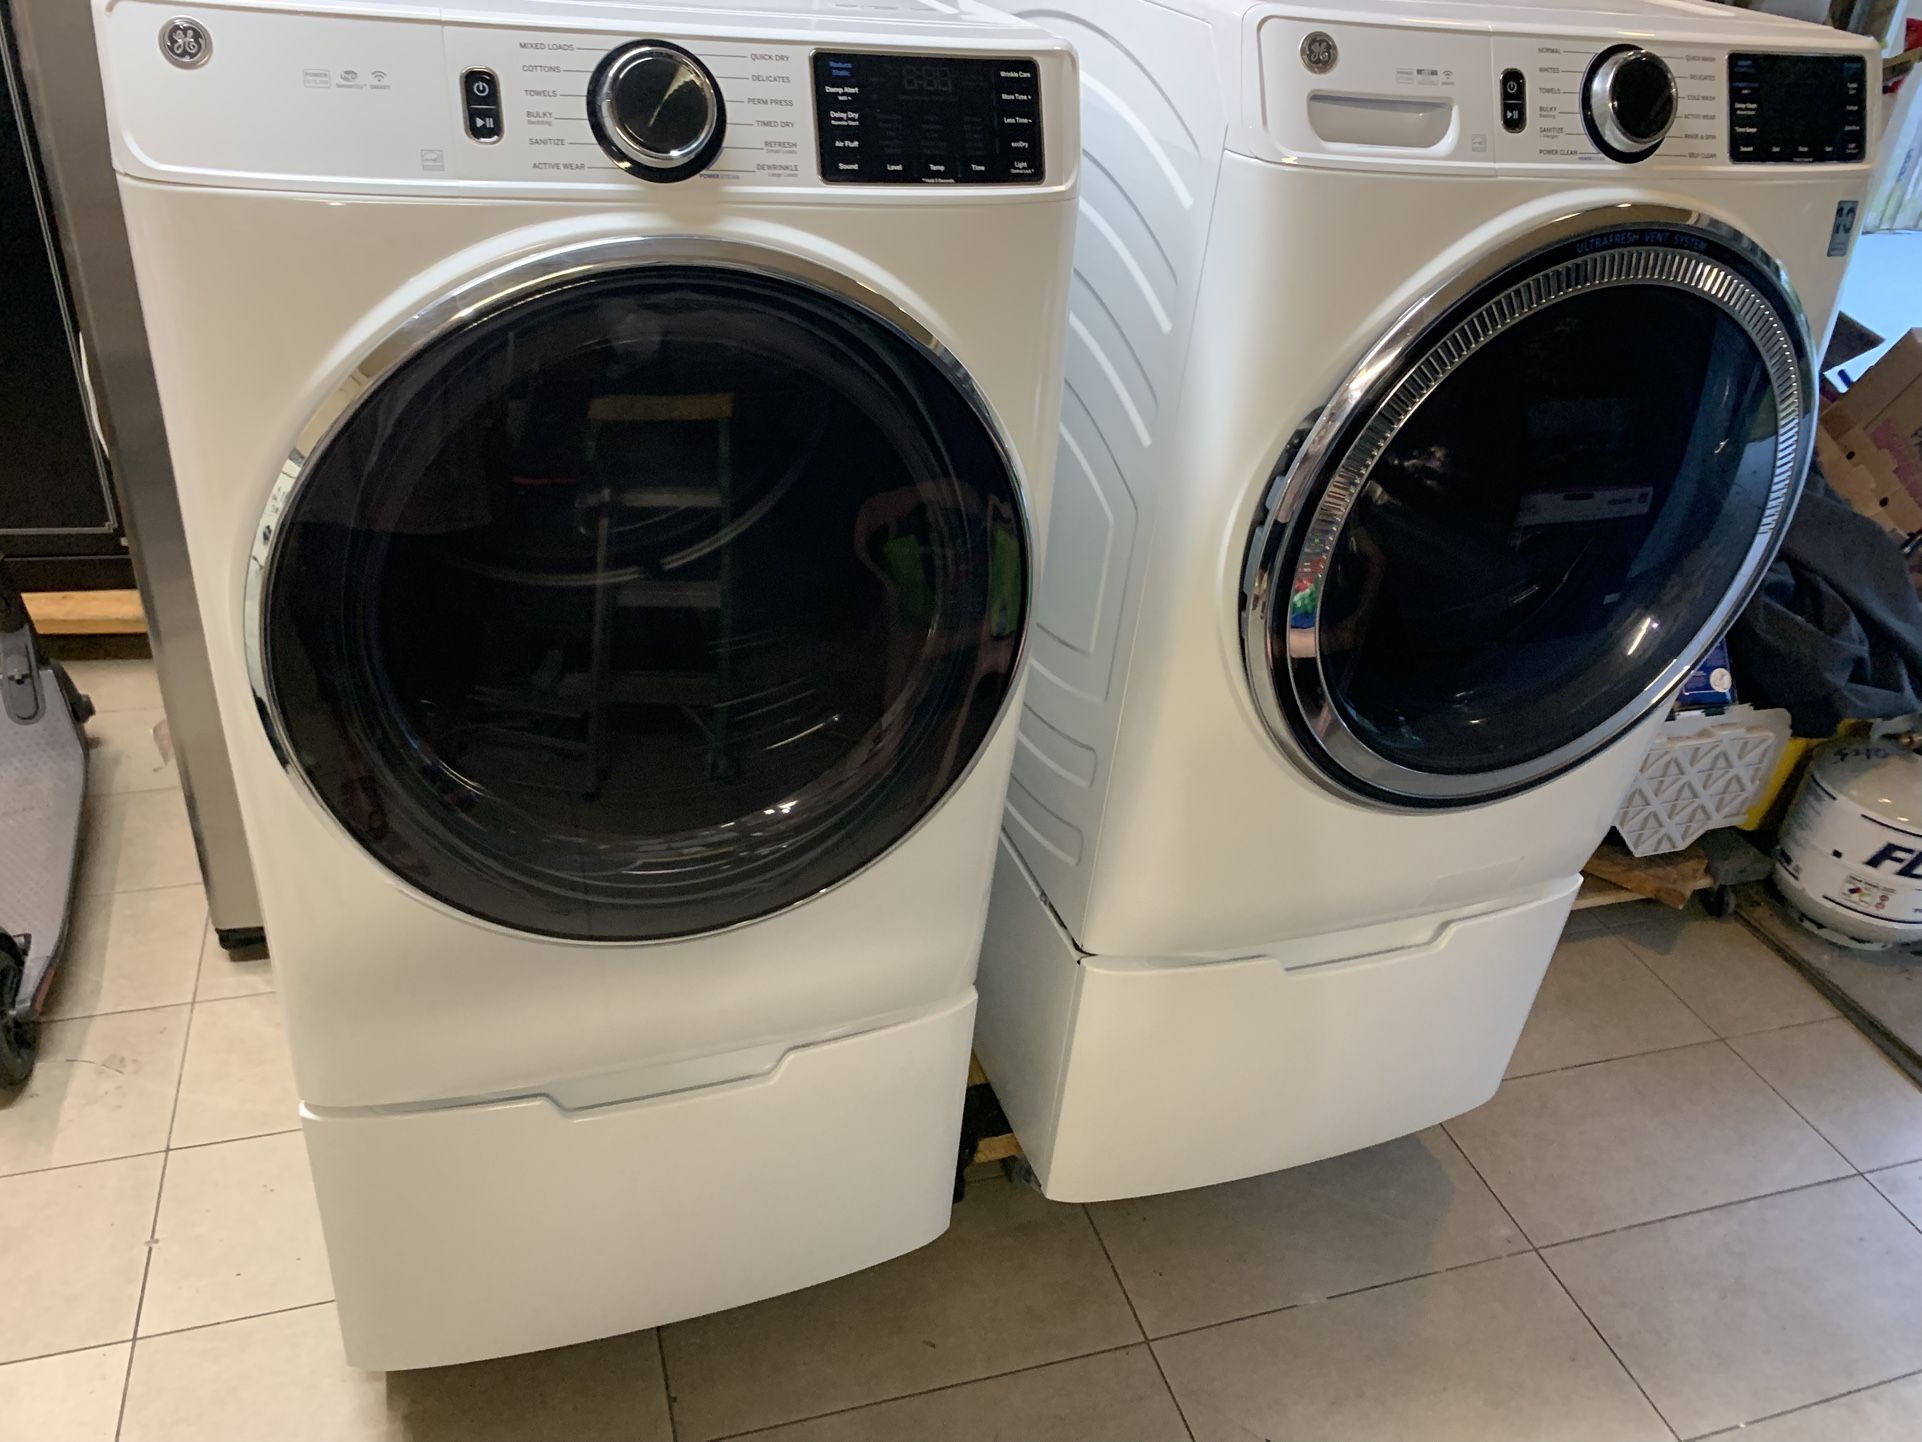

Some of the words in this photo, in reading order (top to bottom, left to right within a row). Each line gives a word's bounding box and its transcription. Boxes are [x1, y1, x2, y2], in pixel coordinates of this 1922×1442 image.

[519, 42, 546, 50] MIXED
[547, 43, 575, 51] LOADS
[750, 53, 774, 61] QUICK
[522, 65, 562, 73] COTTONS
[752, 75, 791, 83] DELICATES
[524, 89, 558, 98] TOWELS
[825, 86, 844, 94] Damp
[747, 98, 768, 106] PERM
[770, 98, 794, 106] PRESS
[830, 110, 846, 120] Delay
[848, 111, 859, 119] Dry
[755, 120, 779, 128] TIMED
[780, 120, 795, 128] DRY
[528, 138, 566, 146] SANITIZE
[532, 162, 560, 170] ACTIVE
[756, 164, 799, 172] DEWRINKLE
[928, 164, 945, 172] Temp
[1576, 232, 1640, 253] ULTRAFRESH
[1644, 231, 1670, 244] VENT
[1674, 234, 1708, 251] SYSTEM
